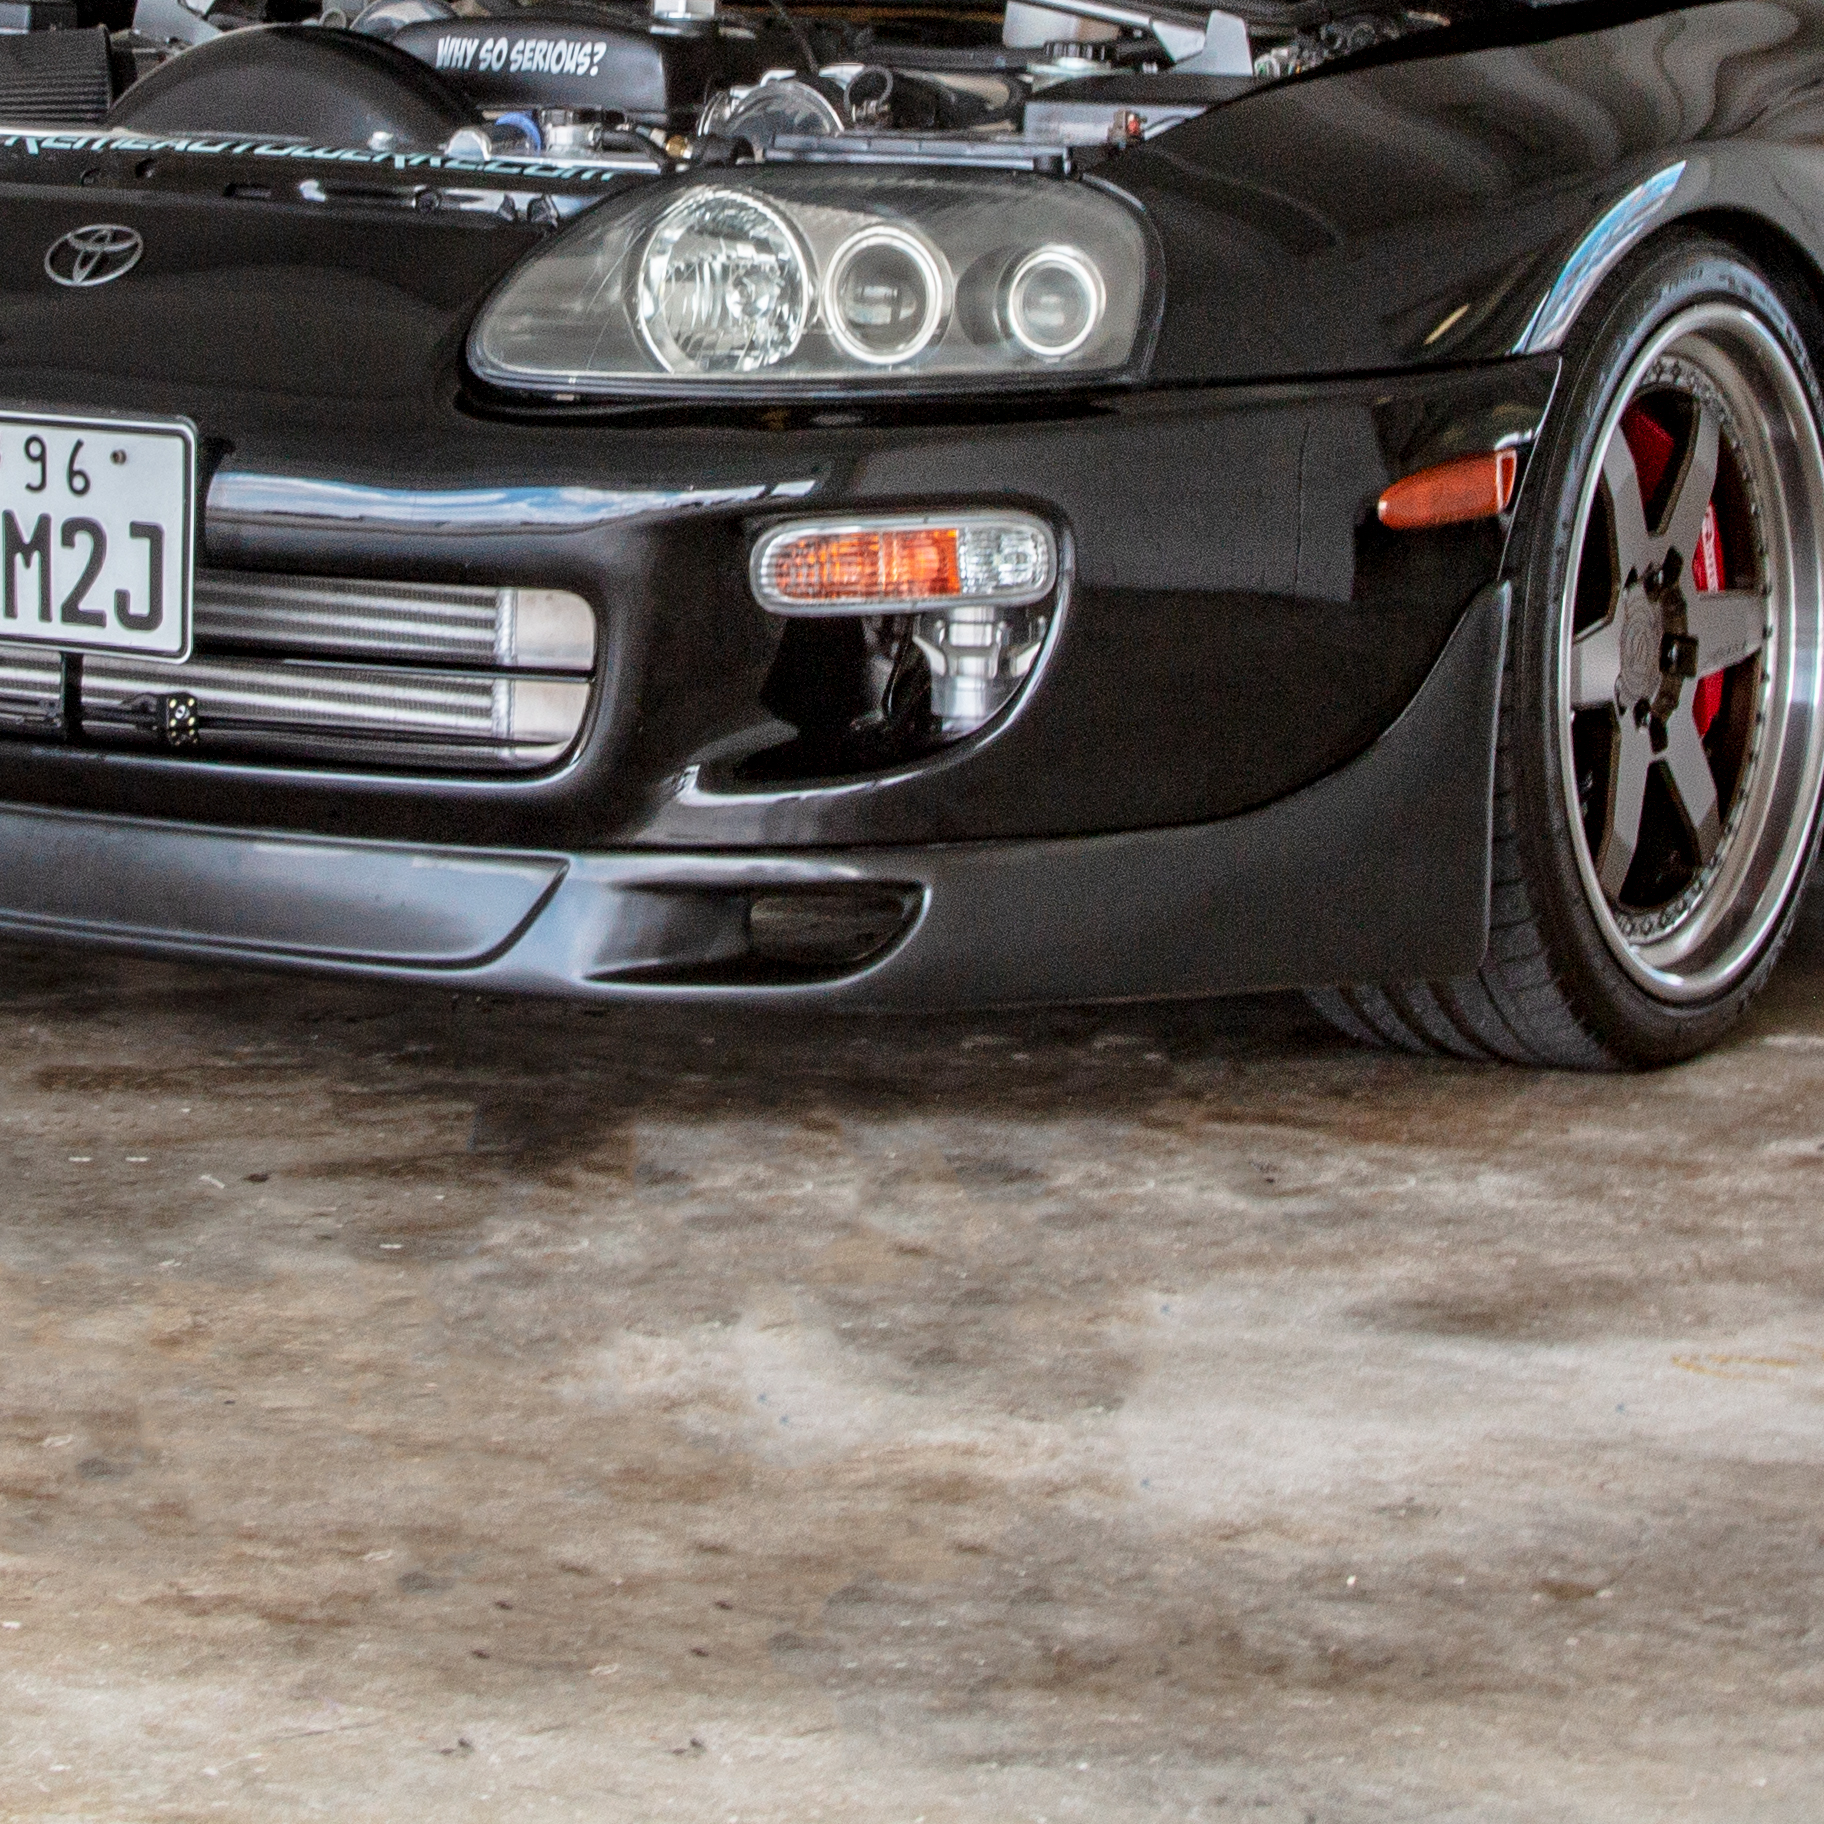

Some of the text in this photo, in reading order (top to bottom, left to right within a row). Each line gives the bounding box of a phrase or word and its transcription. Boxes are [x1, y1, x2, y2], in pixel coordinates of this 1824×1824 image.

[436, 36, 607, 77] WHY SO SERIOUS?
[24, 434, 91, 496] 96
